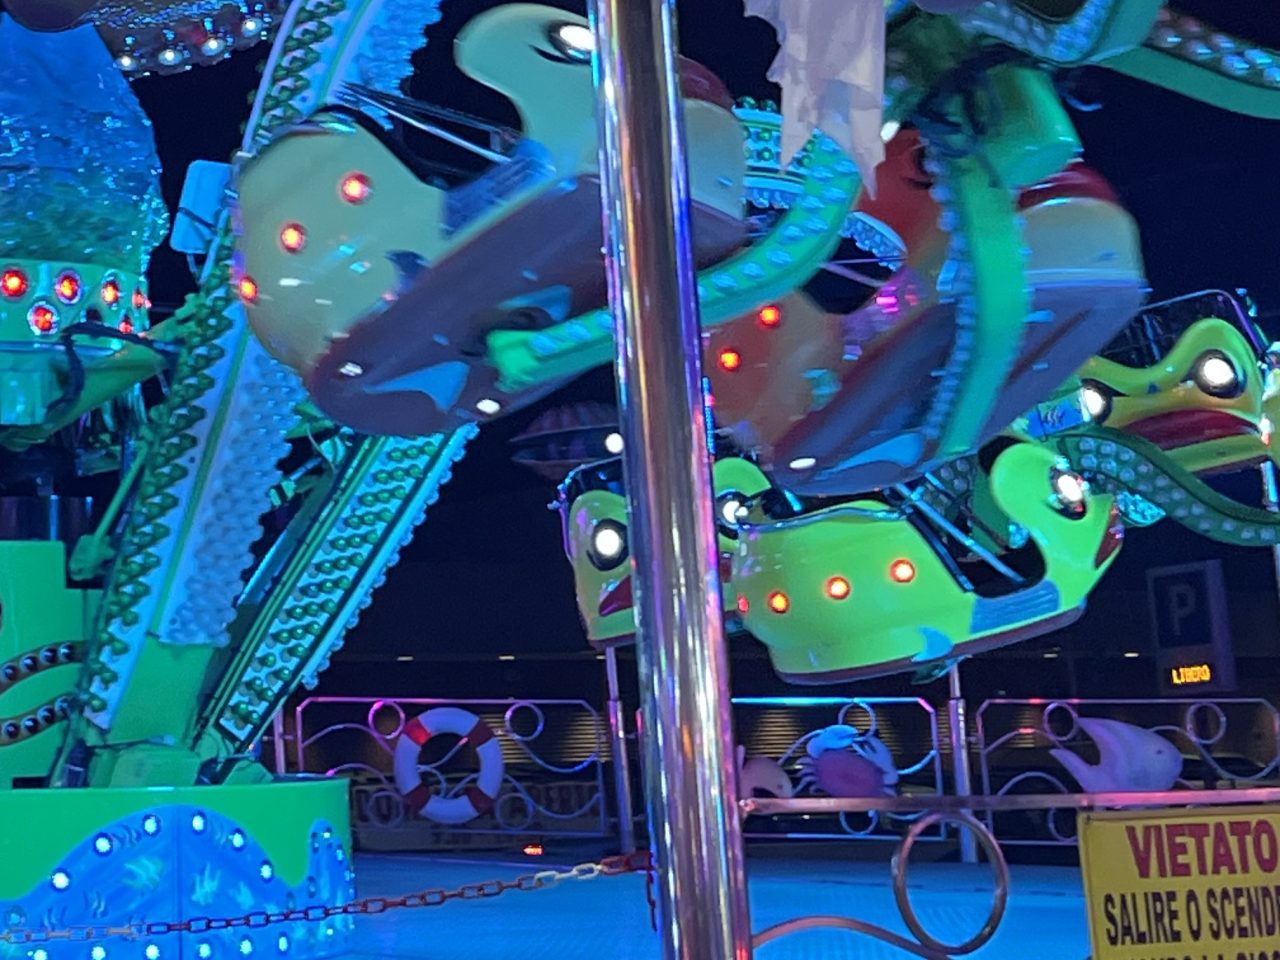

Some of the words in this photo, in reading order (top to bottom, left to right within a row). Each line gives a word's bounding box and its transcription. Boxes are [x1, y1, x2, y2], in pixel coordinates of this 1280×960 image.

[1125, 819, 1279, 879] VIETATO
[1104, 890, 1182, 946] SALIRE
[1186, 889, 1201, 942] O
